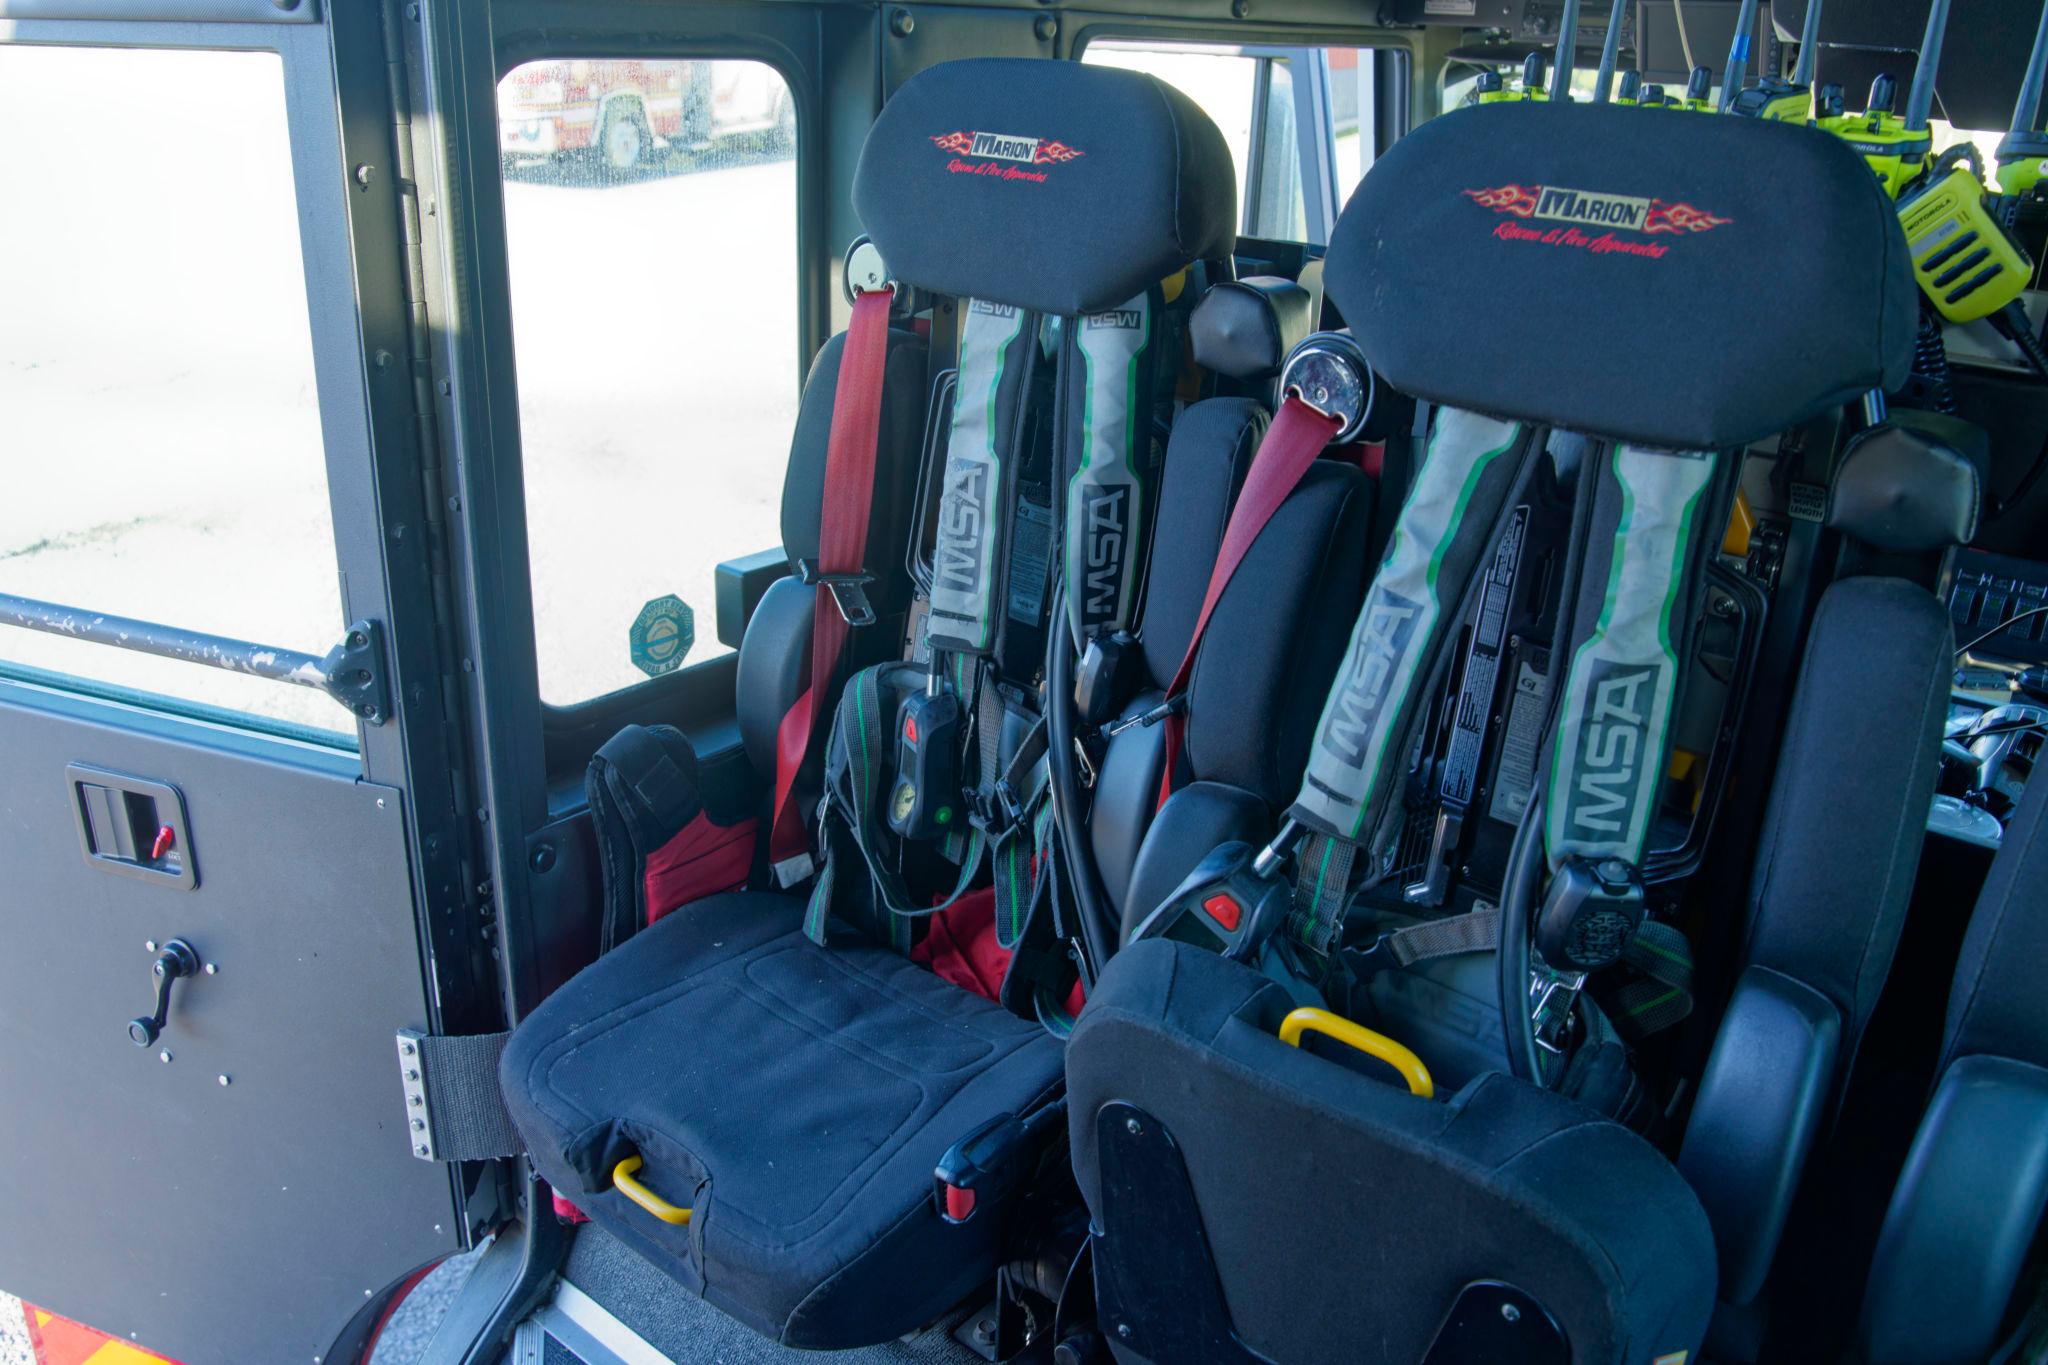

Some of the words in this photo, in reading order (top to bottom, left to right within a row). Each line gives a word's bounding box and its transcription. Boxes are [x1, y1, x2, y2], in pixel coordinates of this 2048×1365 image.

[973, 134, 1034, 159] MARION
[1539, 189, 1641, 225] MARION
[1906, 198, 1952, 232] MOTOROLA
[1587, 232, 1670, 258] Apparatus
[1090, 311, 1139, 328] MSA
[940, 466, 983, 587] MSA
[1086, 488, 1125, 615] MSA
[1329, 603, 1415, 757] MSA
[1573, 670, 1651, 832] MSA
